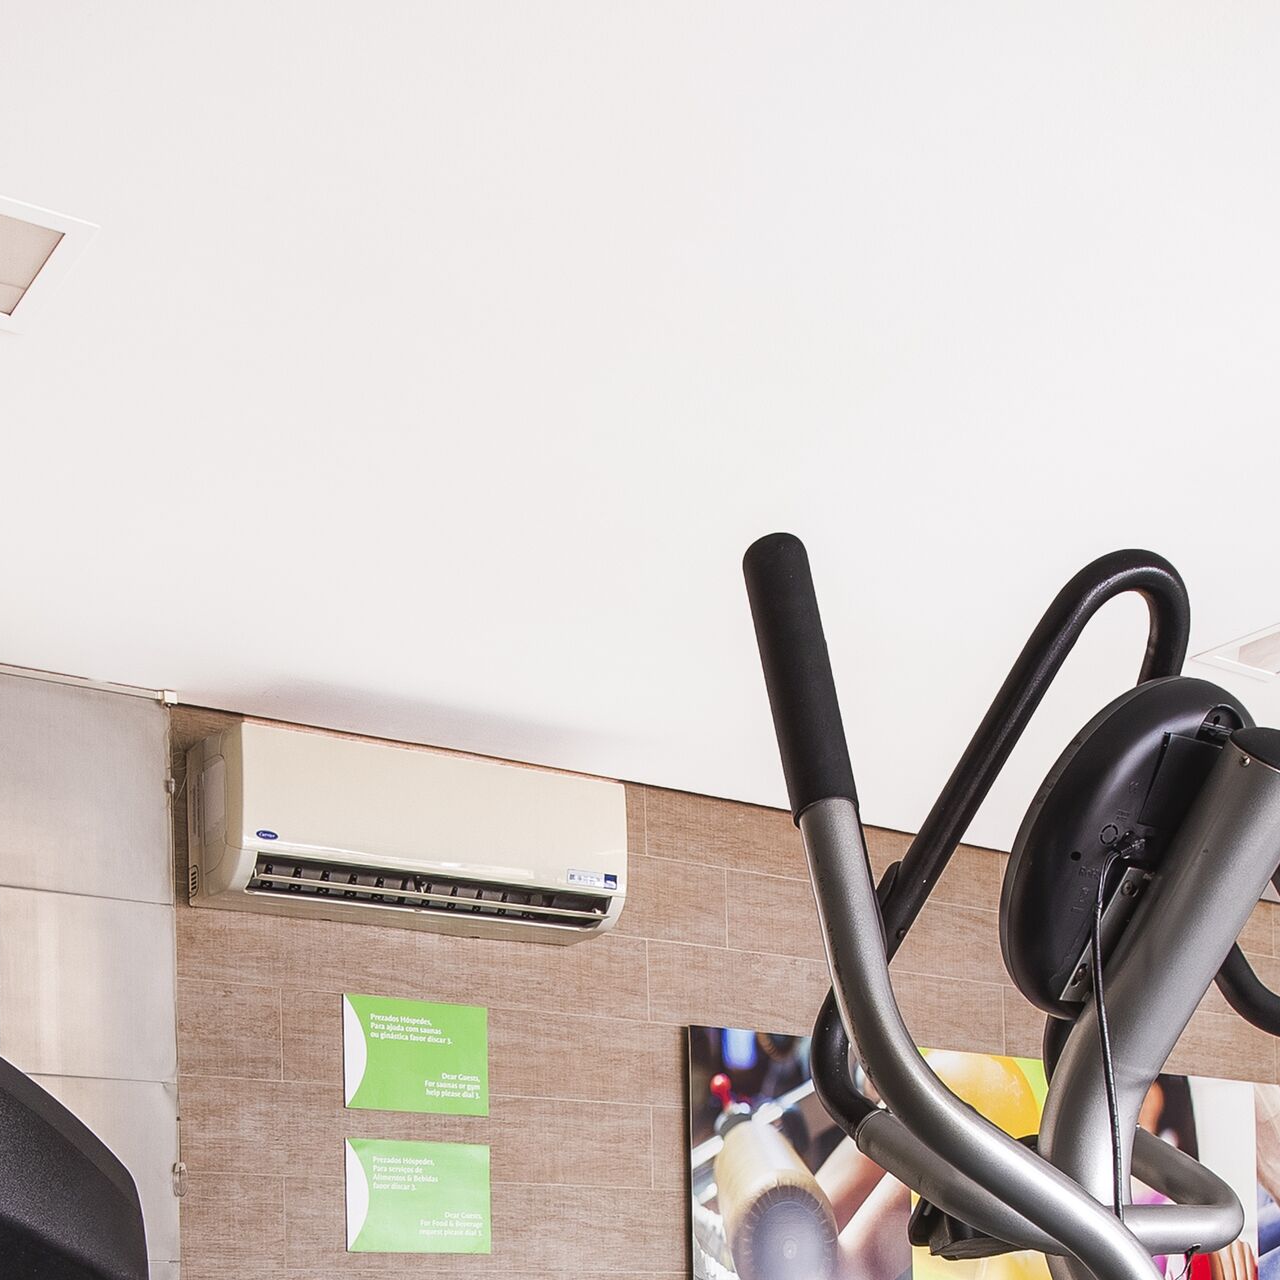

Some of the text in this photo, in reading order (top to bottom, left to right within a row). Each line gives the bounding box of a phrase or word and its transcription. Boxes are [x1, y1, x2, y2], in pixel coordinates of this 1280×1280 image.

[370, 1013, 399, 1022] Prezados
[370, 1022, 385, 1030] Para
[386, 1024, 404, 1032] ajuda
[420, 1027, 442, 1035] saunas
[409, 1033, 426, 1042] favor
[427, 1035, 446, 1044] discar
[441, 1072, 457, 1080] Dear
[436, 1081, 458, 1089] saunas
[466, 1084, 481, 1092] gym
[425, 1088, 440, 1098] help
[440, 1089, 461, 1098] please
[461, 1090, 474, 1099] dial
[372, 1155, 401, 1164] Prezados
